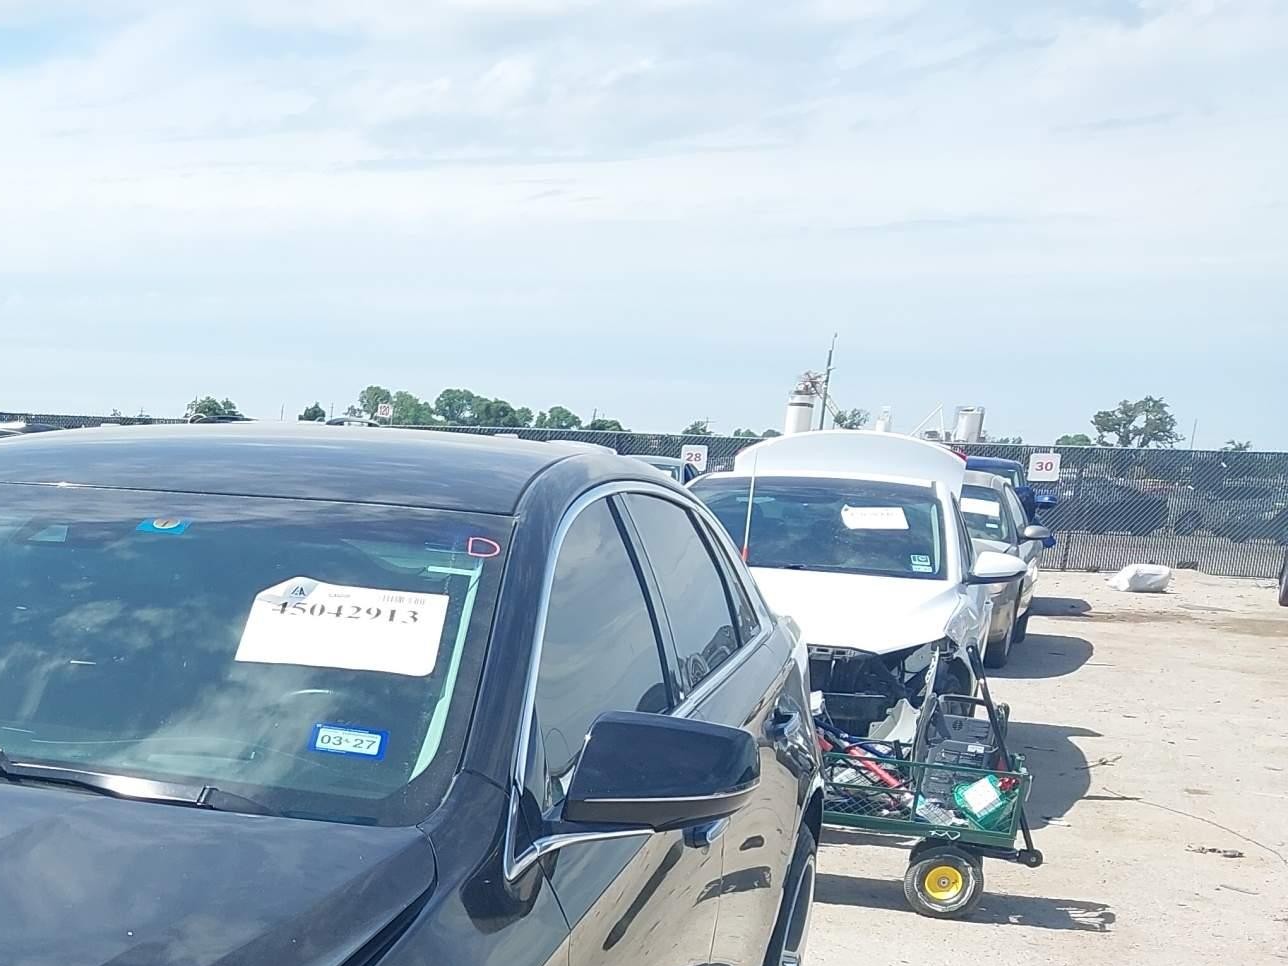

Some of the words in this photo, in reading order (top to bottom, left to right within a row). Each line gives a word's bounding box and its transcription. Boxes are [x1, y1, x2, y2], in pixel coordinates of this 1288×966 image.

[686, 452, 702, 462] 28
[1035, 461, 1054, 472] 30
[468, 537, 500, 557] D
[272, 601, 419, 623] 45042913
